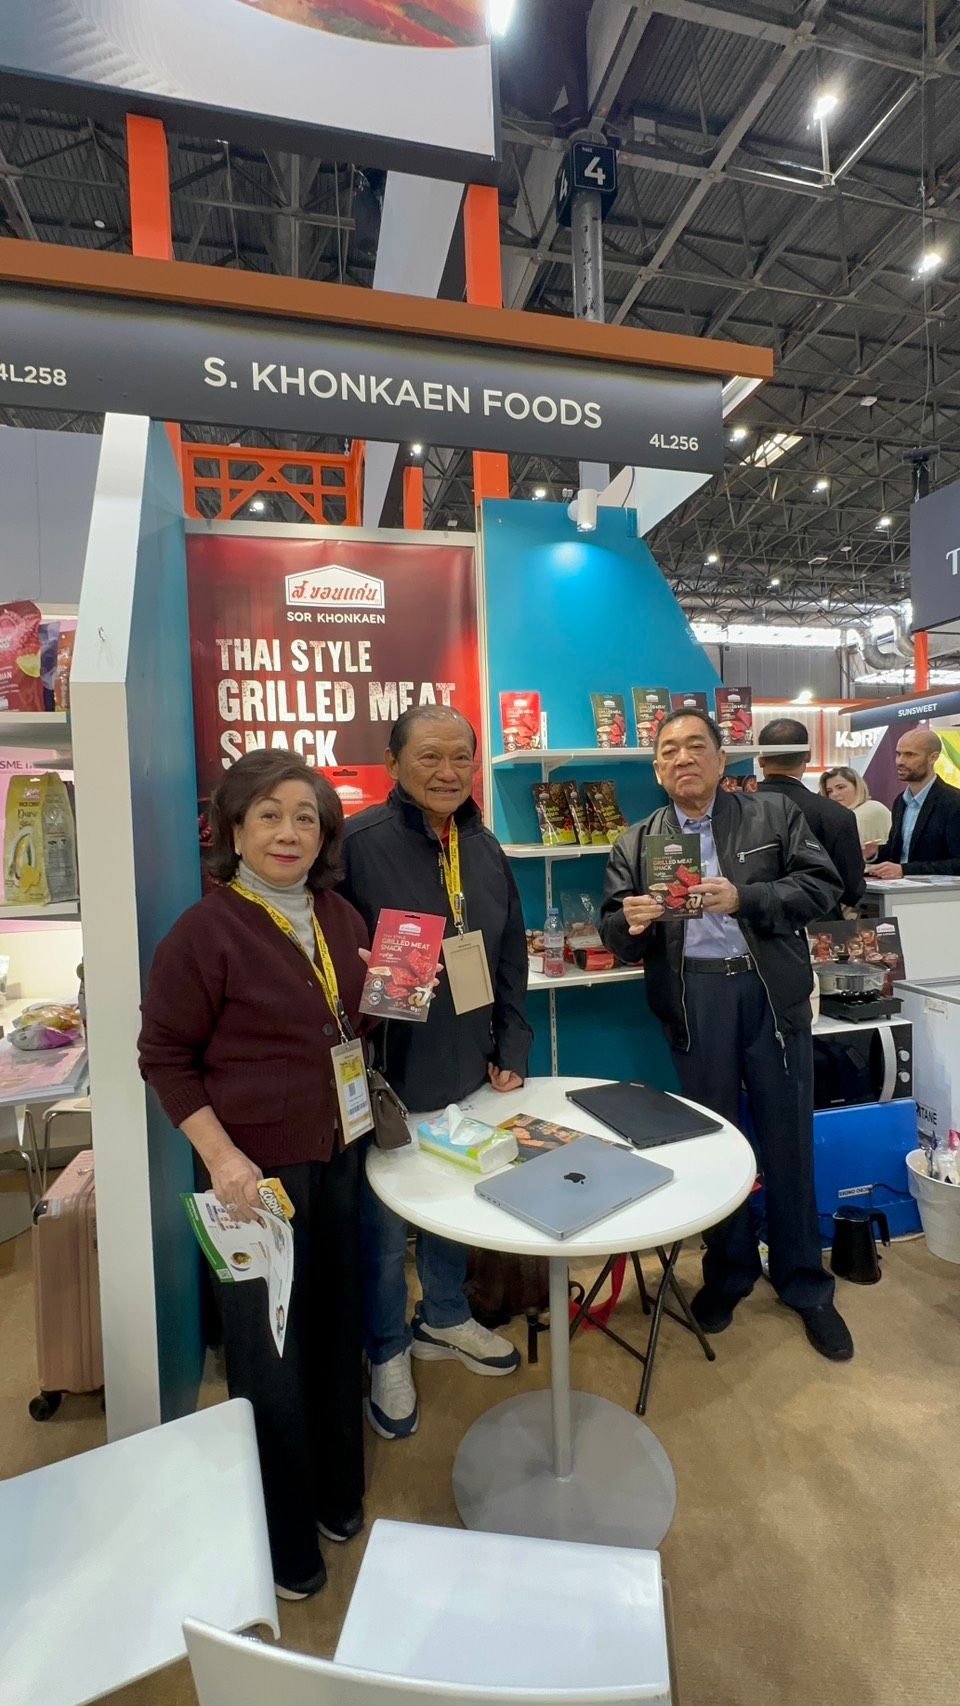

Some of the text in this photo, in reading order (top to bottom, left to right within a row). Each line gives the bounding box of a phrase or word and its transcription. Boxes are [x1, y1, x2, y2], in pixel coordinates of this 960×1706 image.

[584, 156, 606, 186] 4
[203, 356, 602, 429] S. KHONKAEN FOODS
[649, 433, 699, 451] 4L256
[286, 611, 386, 625] SOR KHONKAEN
[215, 638, 373, 673] THAI STYLE
[217, 678, 356, 722] GRILLED
[897, 703, 939, 717] SUNSWEET
[380, 944, 403, 952] SNACK
[381, 937, 431, 951] GRILLED MEAT
[917, 1105, 938, 1126] TANE
